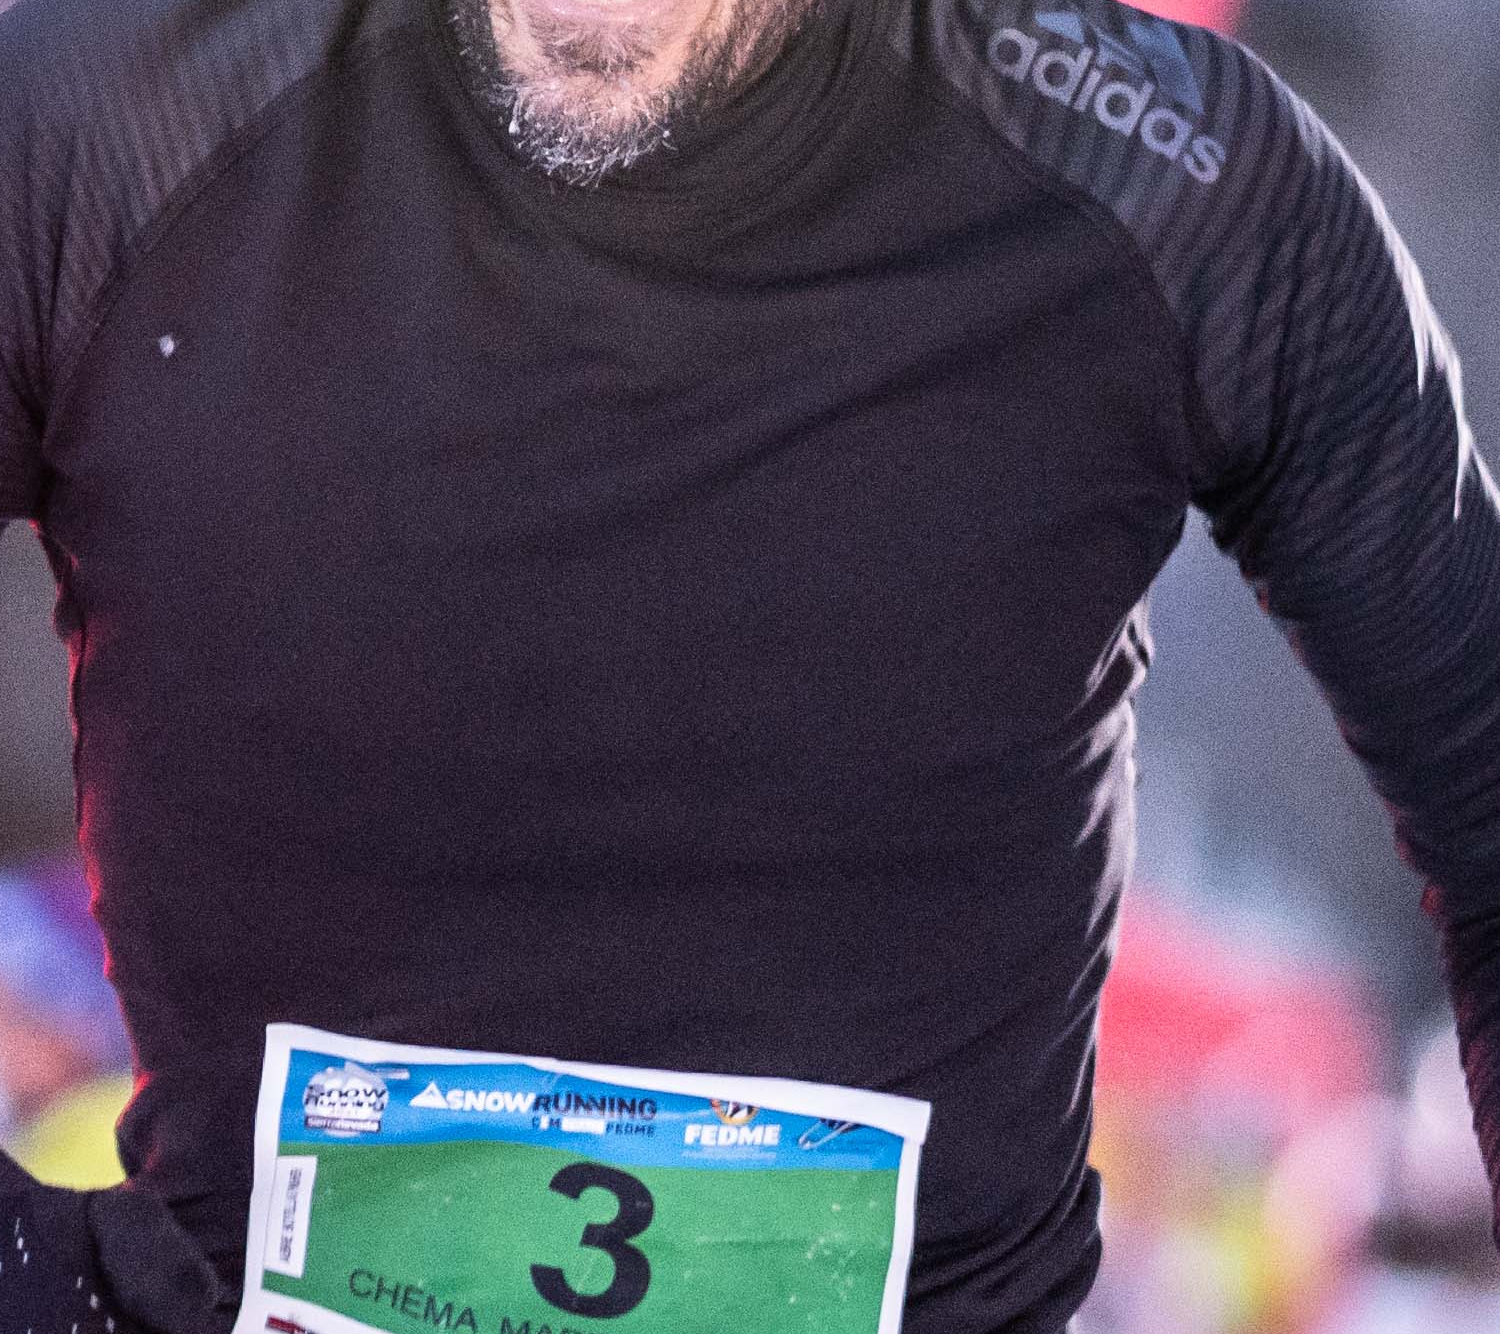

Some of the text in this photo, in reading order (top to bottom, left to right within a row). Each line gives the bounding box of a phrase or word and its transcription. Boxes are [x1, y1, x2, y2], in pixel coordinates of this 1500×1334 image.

[986, 27, 1226, 184] adidas
[683, 1123, 782, 1147] FEDME
[529, 1162, 655, 1319] 3
[349, 1267, 479, 1334] CHEMA
